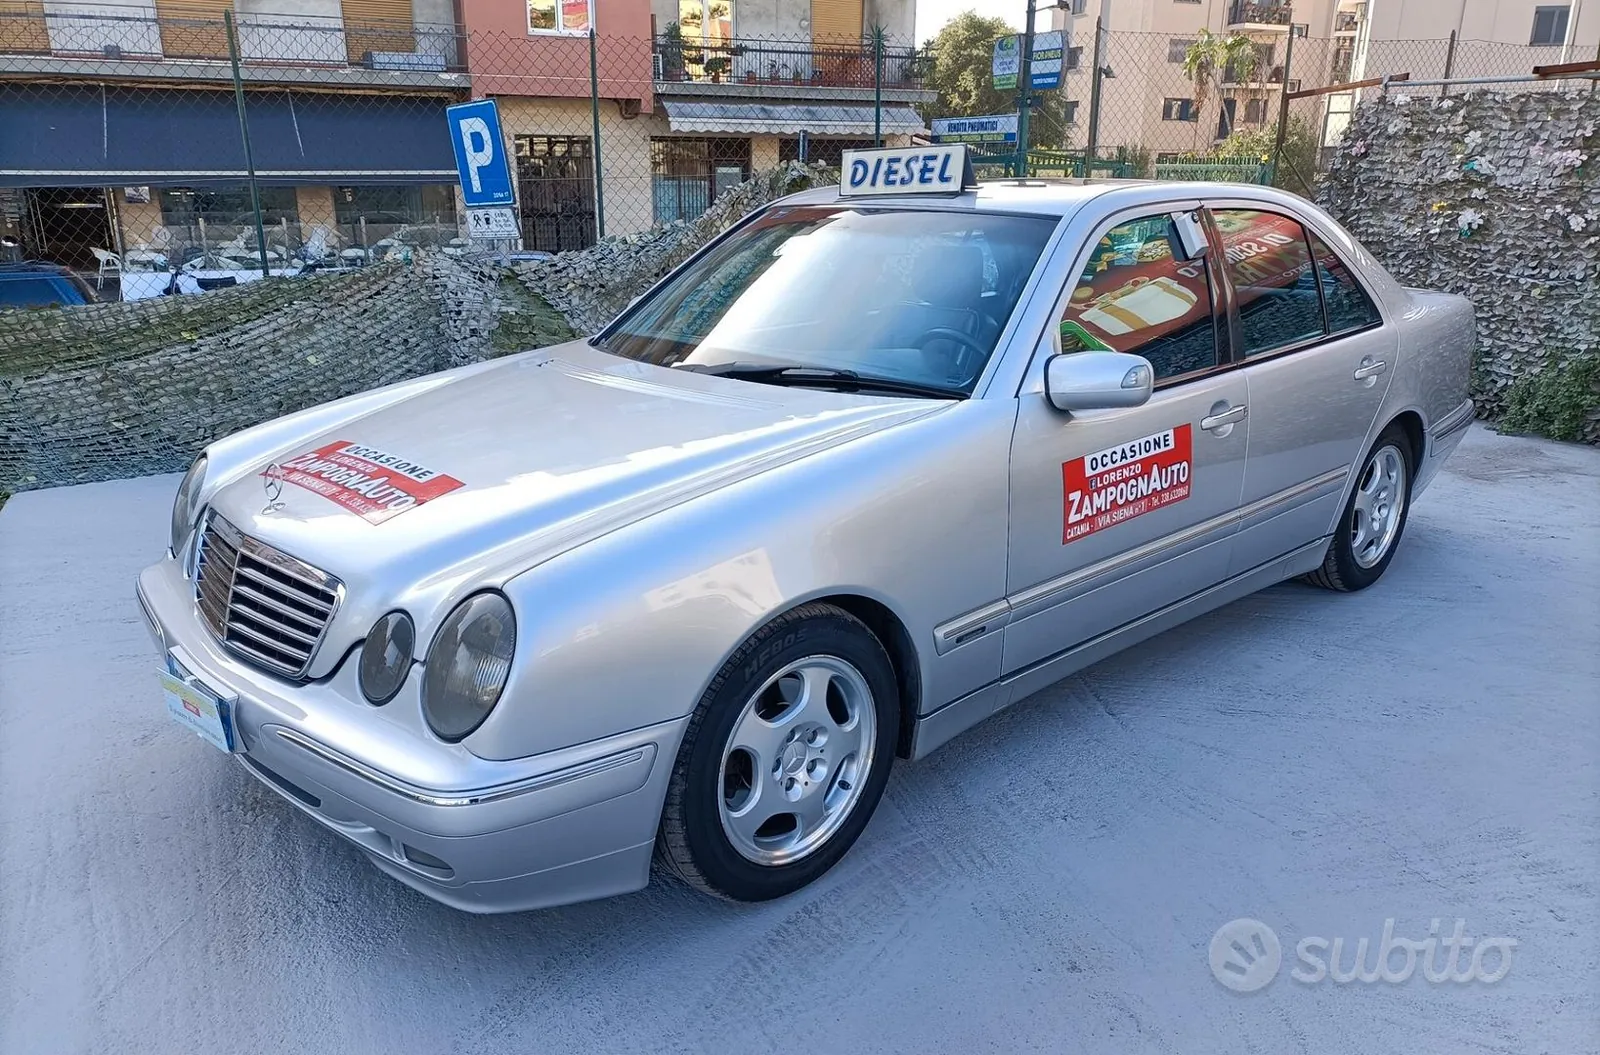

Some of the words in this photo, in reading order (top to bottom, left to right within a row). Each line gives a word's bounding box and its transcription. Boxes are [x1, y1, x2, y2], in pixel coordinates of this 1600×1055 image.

[948, 122, 967, 133] VENDITA
[968, 120, 998, 132] PNEUMATICI
[459, 117, 493, 193] P
[850, 153, 952, 188] DIESEL
[328, 453, 378, 473] LORENZO
[345, 445, 434, 480] OCCASIONE
[1091, 434, 1170, 471] OCCASIONE
[1097, 464, 1141, 487] LORENZO
[1067, 521, 1090, 539] CATANIA
[1098, 513, 1111, 527] VIA
[1112, 505, 1133, 522] SIENA
